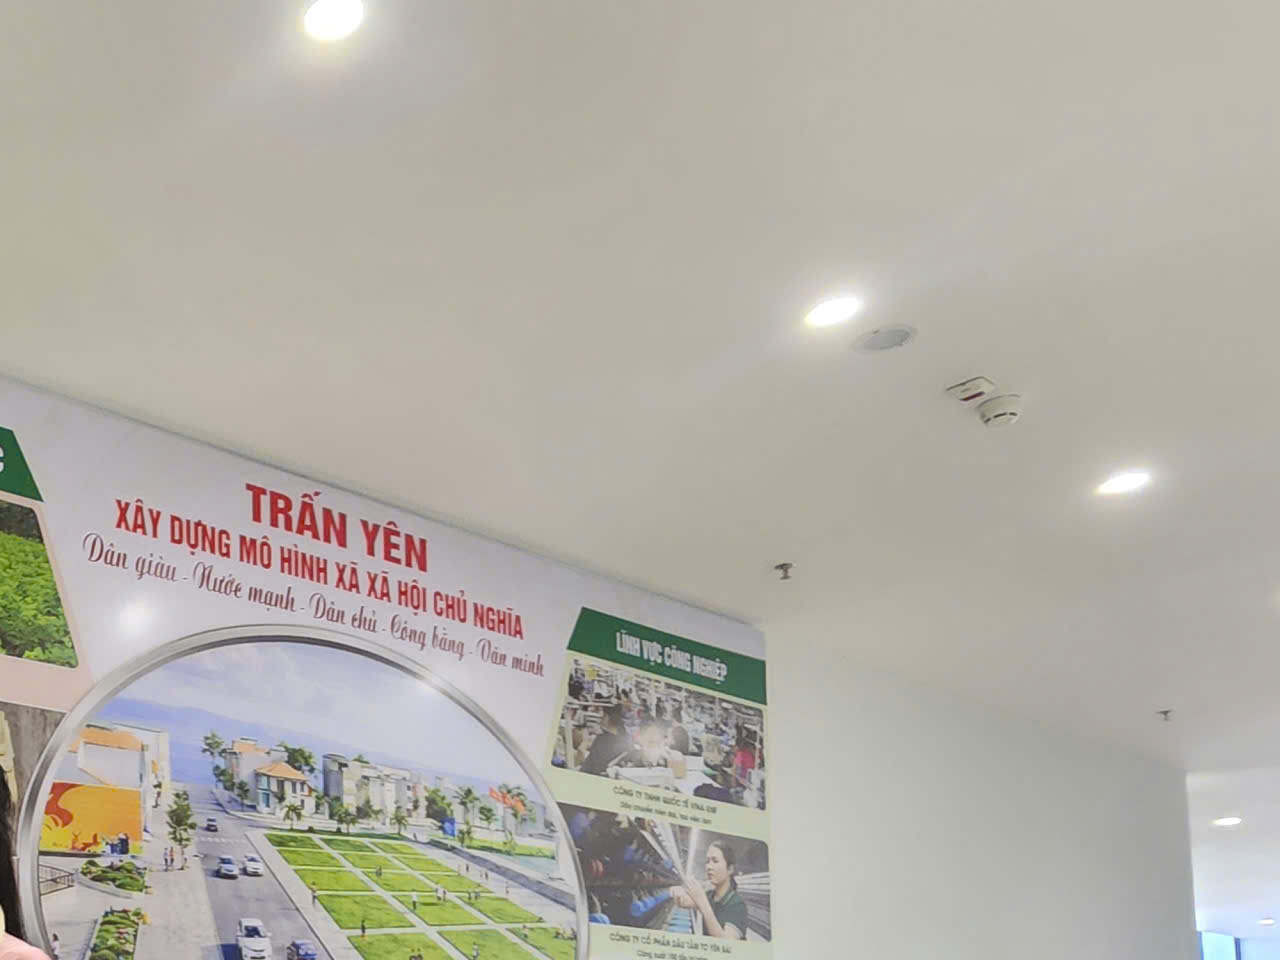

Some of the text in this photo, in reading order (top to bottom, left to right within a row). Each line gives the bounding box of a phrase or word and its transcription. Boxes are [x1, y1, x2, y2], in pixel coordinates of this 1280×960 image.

[115, 498, 525, 640] XÂY DỰNG MÔ HÌNH XÃ XÃ HỘI CHỦ NGHĨA
[245, 482, 428, 573] TRẤN YÊN
[82, 532, 129, 570] Dân
[135, 552, 177, 581] giàu
[192, 561, 243, 599] Nước
[248, 586, 297, 612] mạnh
[308, 592, 346, 625] Dân
[351, 605, 377, 634] chủ
[389, 614, 427, 651] Công
[511, 654, 545, 678] minh
